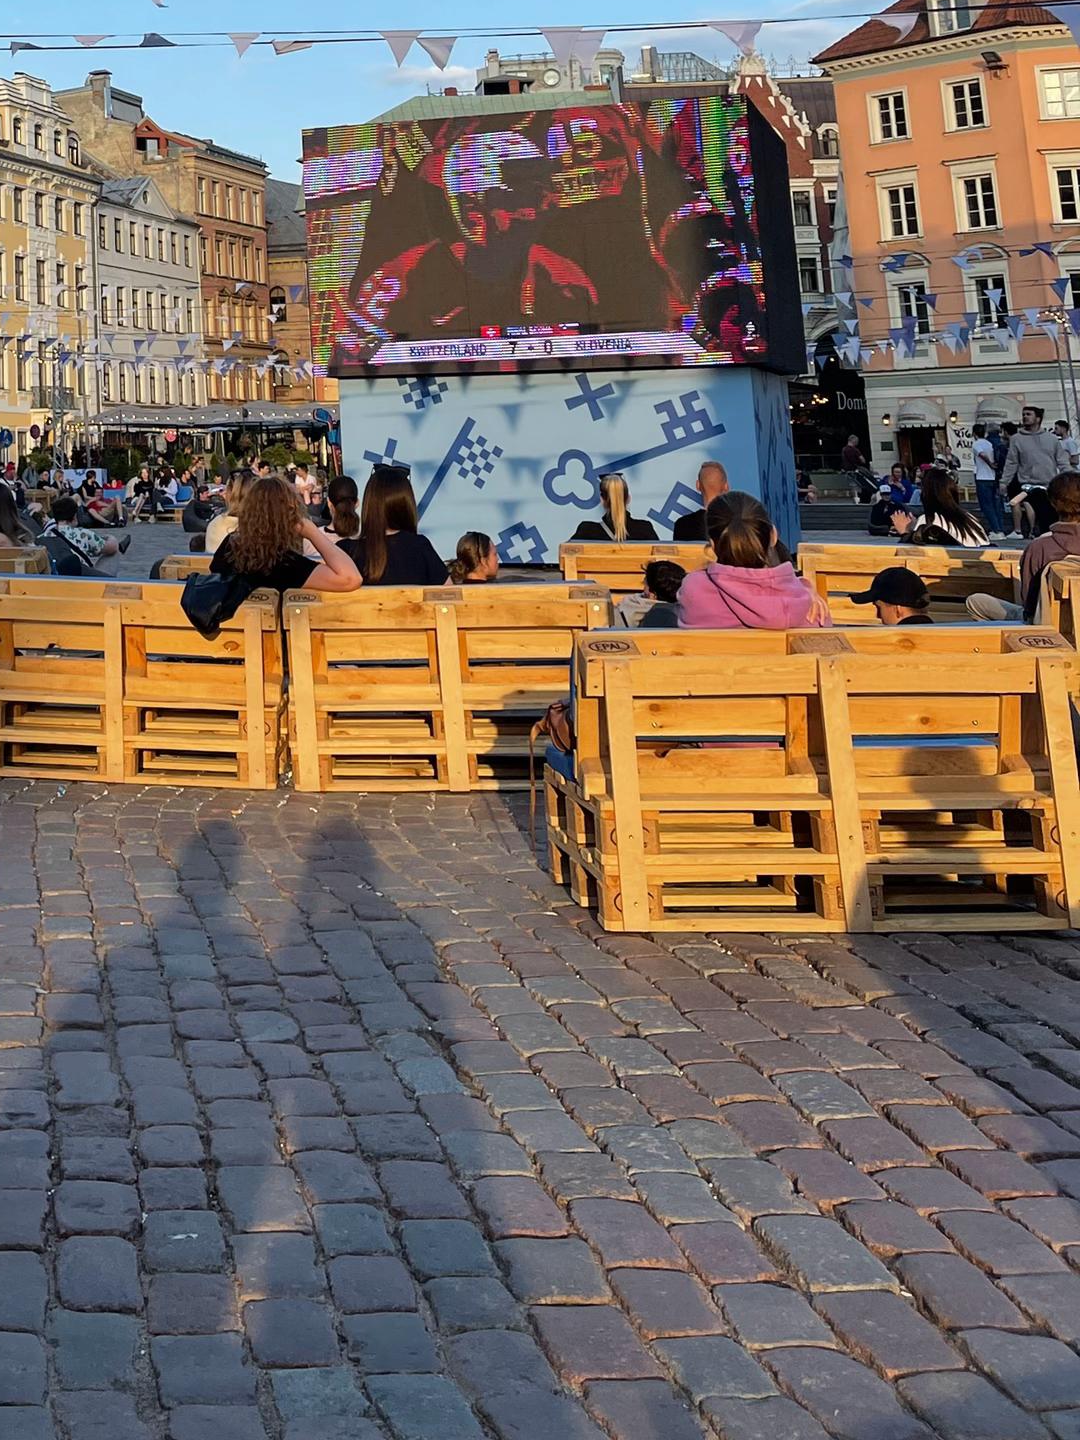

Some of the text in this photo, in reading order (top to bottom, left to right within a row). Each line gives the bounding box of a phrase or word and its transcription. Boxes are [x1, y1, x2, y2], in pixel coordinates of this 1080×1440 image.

[508, 340, 518, 355] 7
[594, 640, 627, 652] EPAL
[1025, 636, 1058, 648] EPAL
